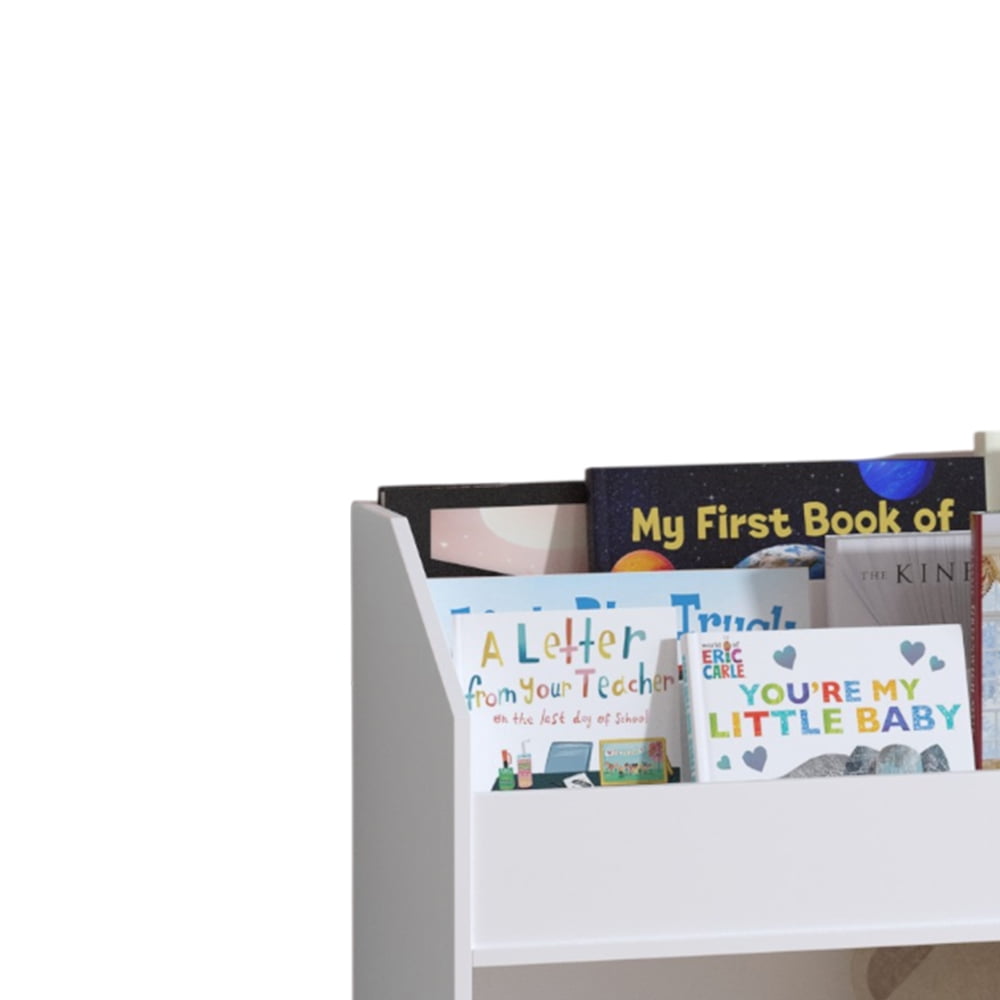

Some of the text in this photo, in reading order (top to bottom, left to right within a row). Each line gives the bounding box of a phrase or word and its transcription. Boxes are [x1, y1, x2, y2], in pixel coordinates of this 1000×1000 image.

[632, 498, 955, 550] My First Book of
[862, 571, 886, 581] THE
[481, 617, 647, 668] A Letter
[465, 662, 675, 711] from your Teacher
[703, 664, 745, 680] CARLE
[739, 679, 920, 706] YOU'RE MY
[493, 714, 508, 724] on
[513, 712, 533, 725] the
[540, 709, 565, 725] last
[573, 710, 592, 728] day
[597, 712, 610, 726] of
[709, 708, 844, 738] LITTLE
[856, 704, 961, 733] BABY
